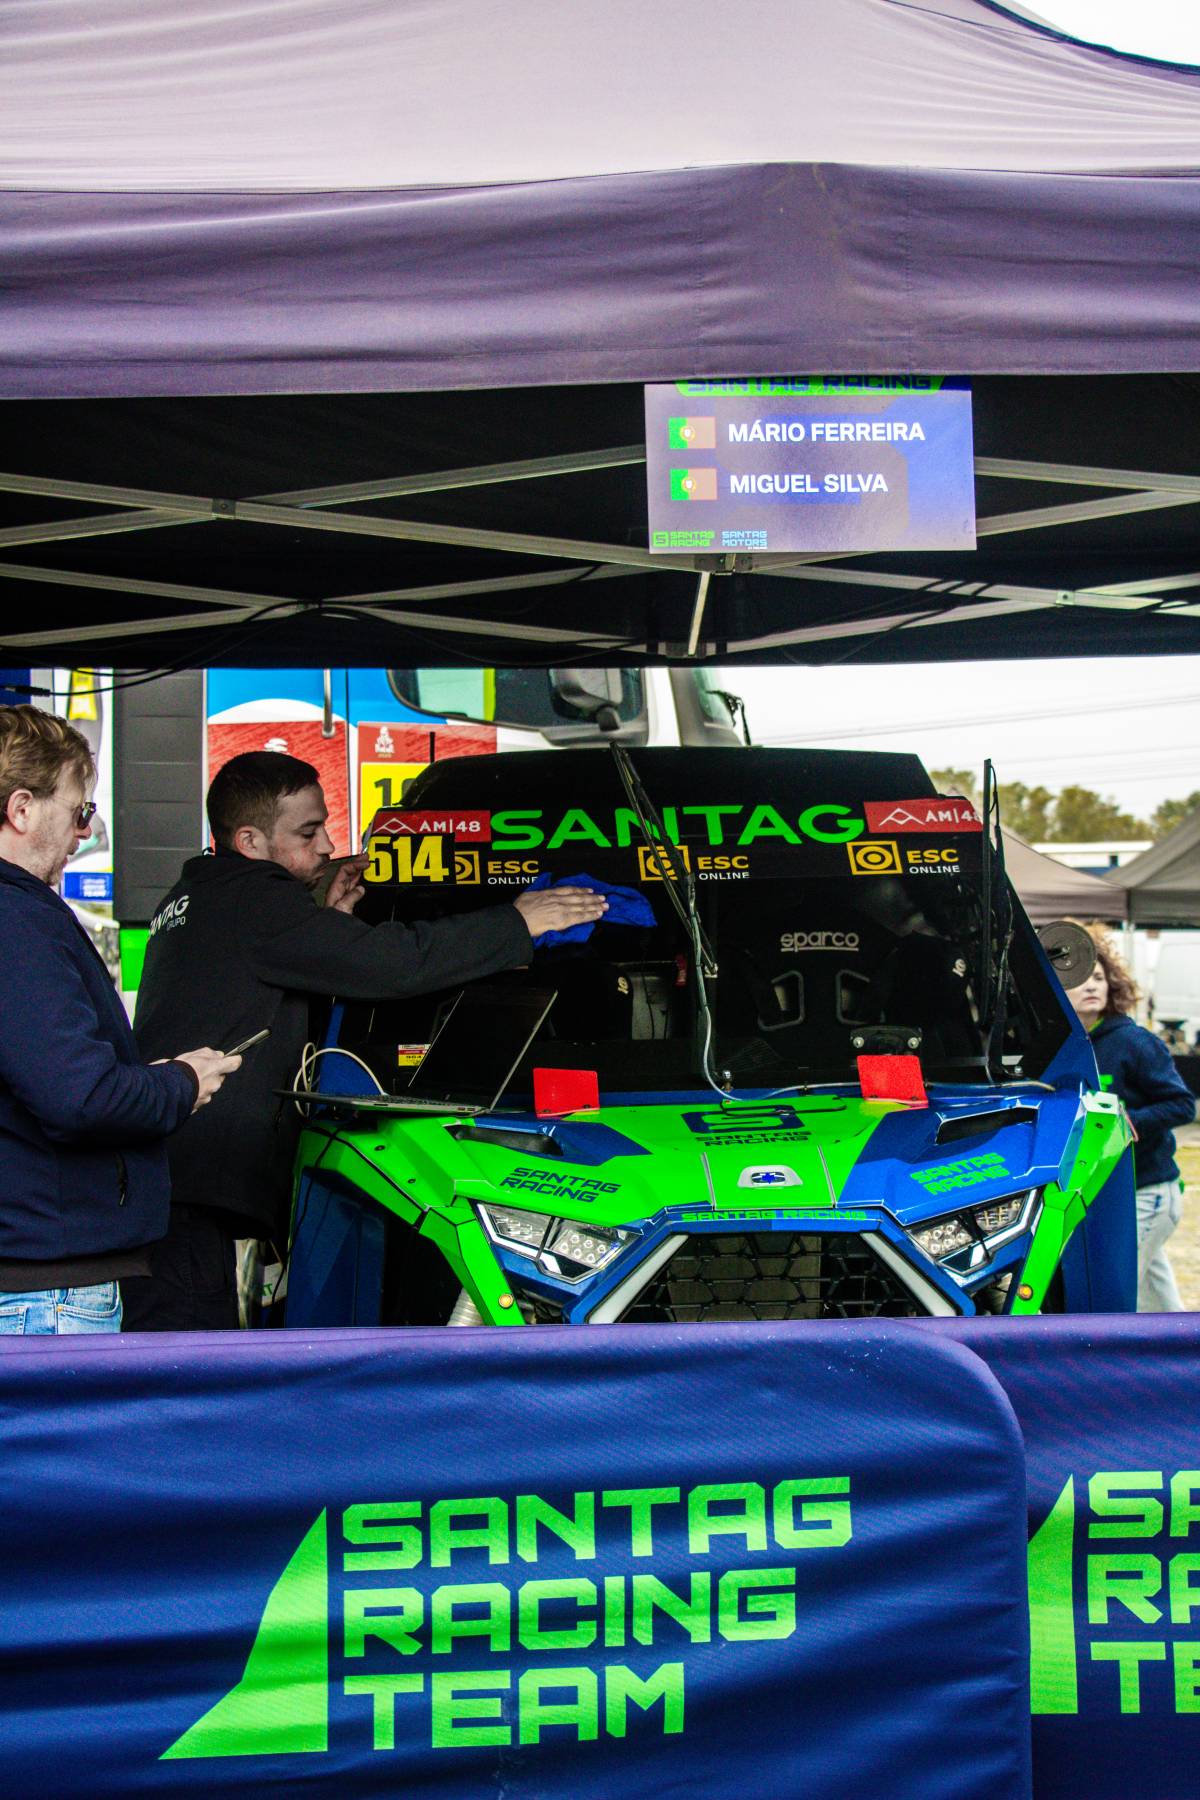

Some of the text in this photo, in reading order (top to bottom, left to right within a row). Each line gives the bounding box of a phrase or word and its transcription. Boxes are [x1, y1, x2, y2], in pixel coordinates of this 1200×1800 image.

[728, 419, 925, 442] MÁRIO FERREIRA
[730, 473, 888, 494] MIGUEL SILVA
[722, 530, 767, 538] SANTAG
[722, 538, 767, 546] MOTORS
[490, 804, 865, 851] SANTAG
[363, 835, 450, 883] 514
[697, 855, 749, 870] ESC
[906, 848, 959, 864] ESC
[487, 860, 540, 874] ESC
[698, 871, 750, 881] ONLINE
[909, 864, 961, 874] ONLINE
[781, 931, 859, 952] sparco
[695, 1131, 812, 1141] SANTAG
[704, 1136, 809, 1146] RACING
[910, 1152, 1006, 1184] SANTAG
[499, 1177, 600, 1203] RACING
[510, 1167, 621, 1194] SANTAG
[922, 1165, 1009, 1195] RACING
[681, 1210, 868, 1222] SANTAG RACING
[343, 1477, 852, 1571] SANTAG
[344, 1568, 796, 1658] RACING
[344, 1663, 685, 1750] TEAM
